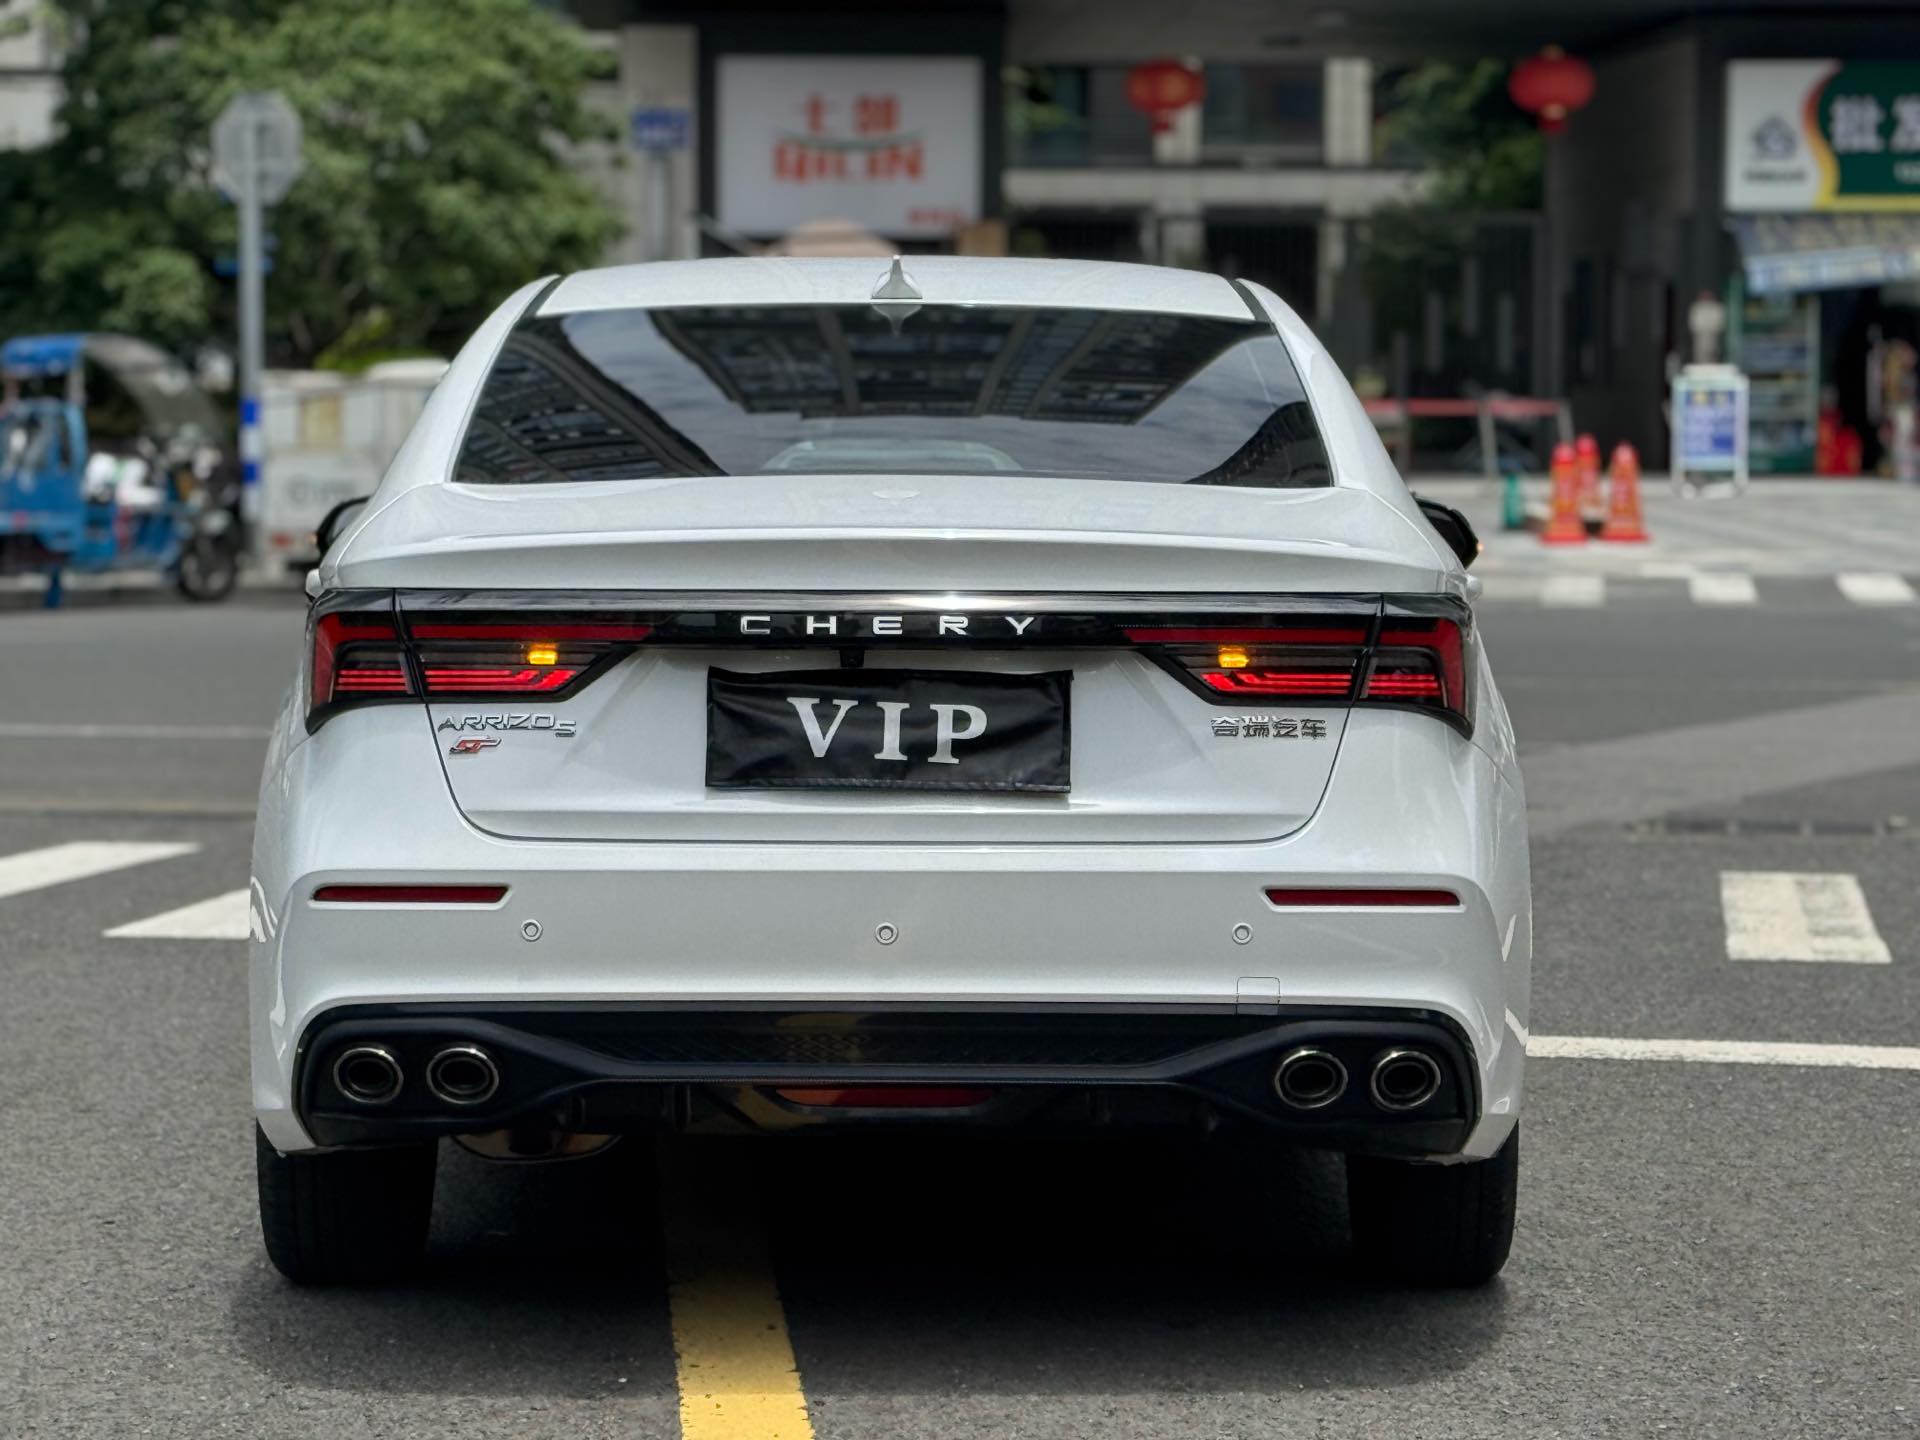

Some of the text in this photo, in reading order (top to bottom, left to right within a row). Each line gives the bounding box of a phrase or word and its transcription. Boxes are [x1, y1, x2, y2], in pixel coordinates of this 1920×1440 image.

[740, 615, 1035, 636] CHERY
[786, 696, 988, 765] VIP
[1211, 715, 1327, 739] 奇瑞汽车
